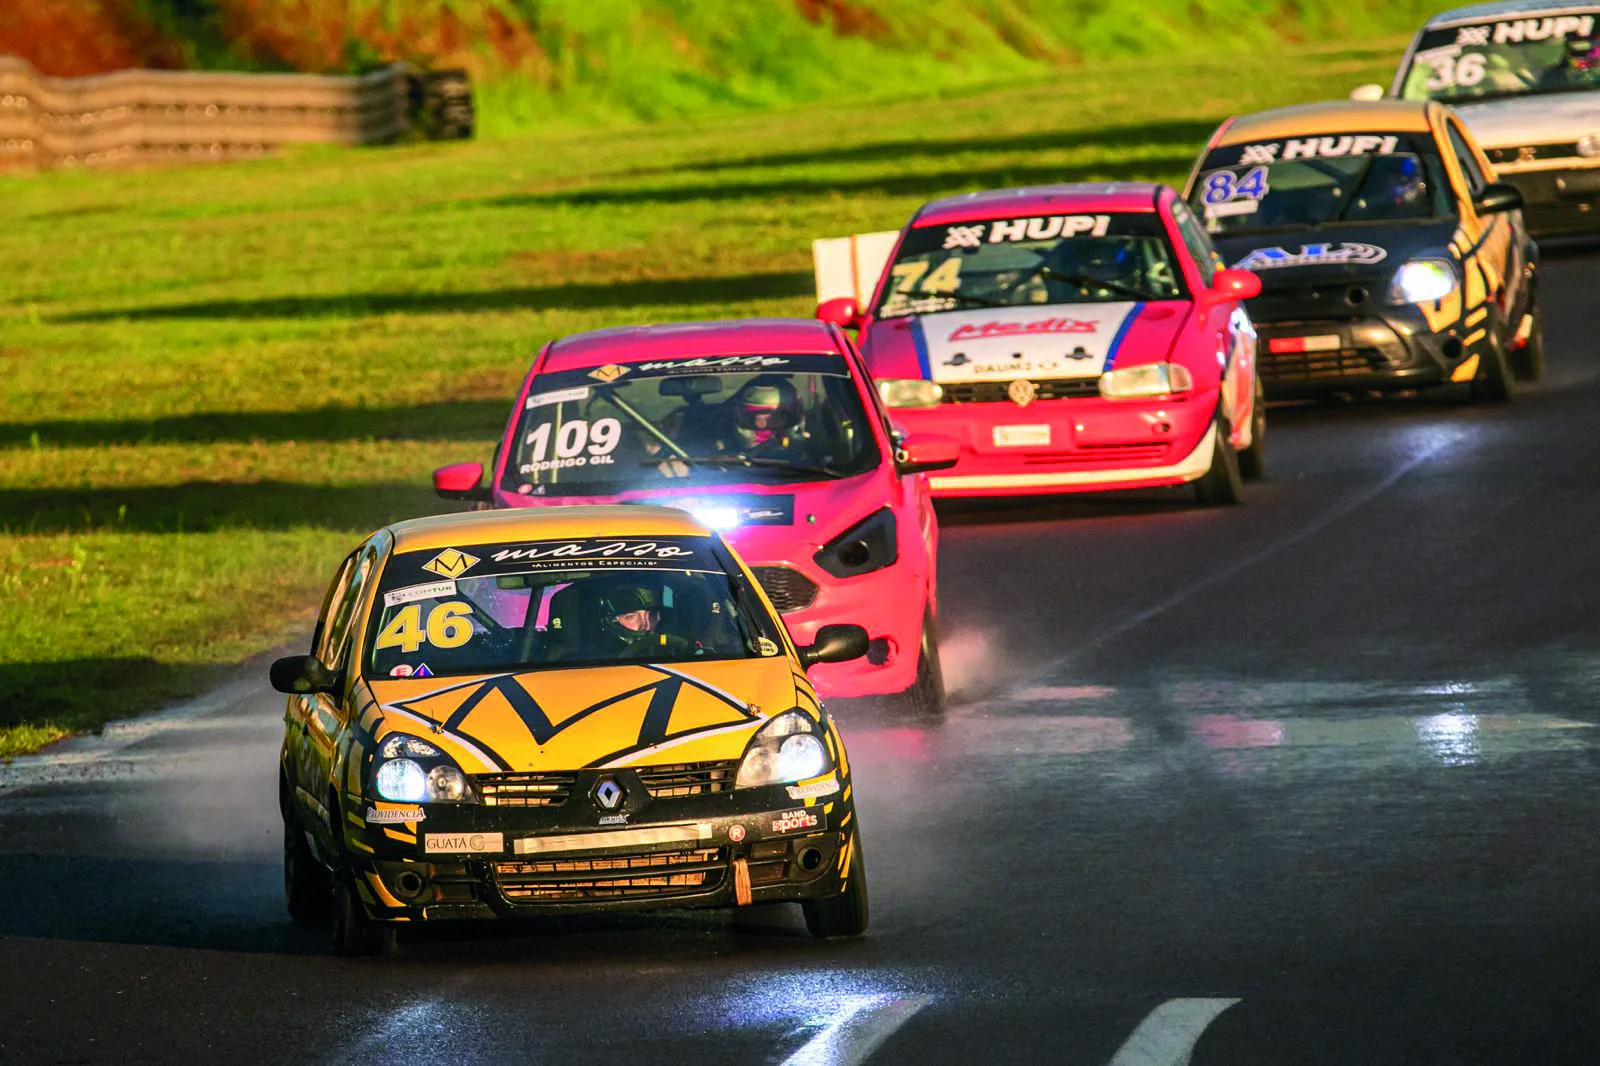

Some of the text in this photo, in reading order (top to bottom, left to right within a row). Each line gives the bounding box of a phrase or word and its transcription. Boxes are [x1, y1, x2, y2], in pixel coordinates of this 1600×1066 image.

[1493, 15, 1595, 44] HUPI
[1427, 52, 1487, 91] 36
[1282, 135, 1399, 160] HUPI
[1201, 165, 1269, 206] 84
[988, 214, 1111, 244] HUPI
[893, 257, 962, 293] 74
[526, 417, 622, 461] 109
[520, 455, 615, 474] RODRIGO GIL
[491, 542, 693, 561] masso
[376, 601, 474, 653] 46
[772, 815, 818, 833] sports
[782, 810, 807, 820] BAND
[426, 838, 467, 850] GUATÁ
